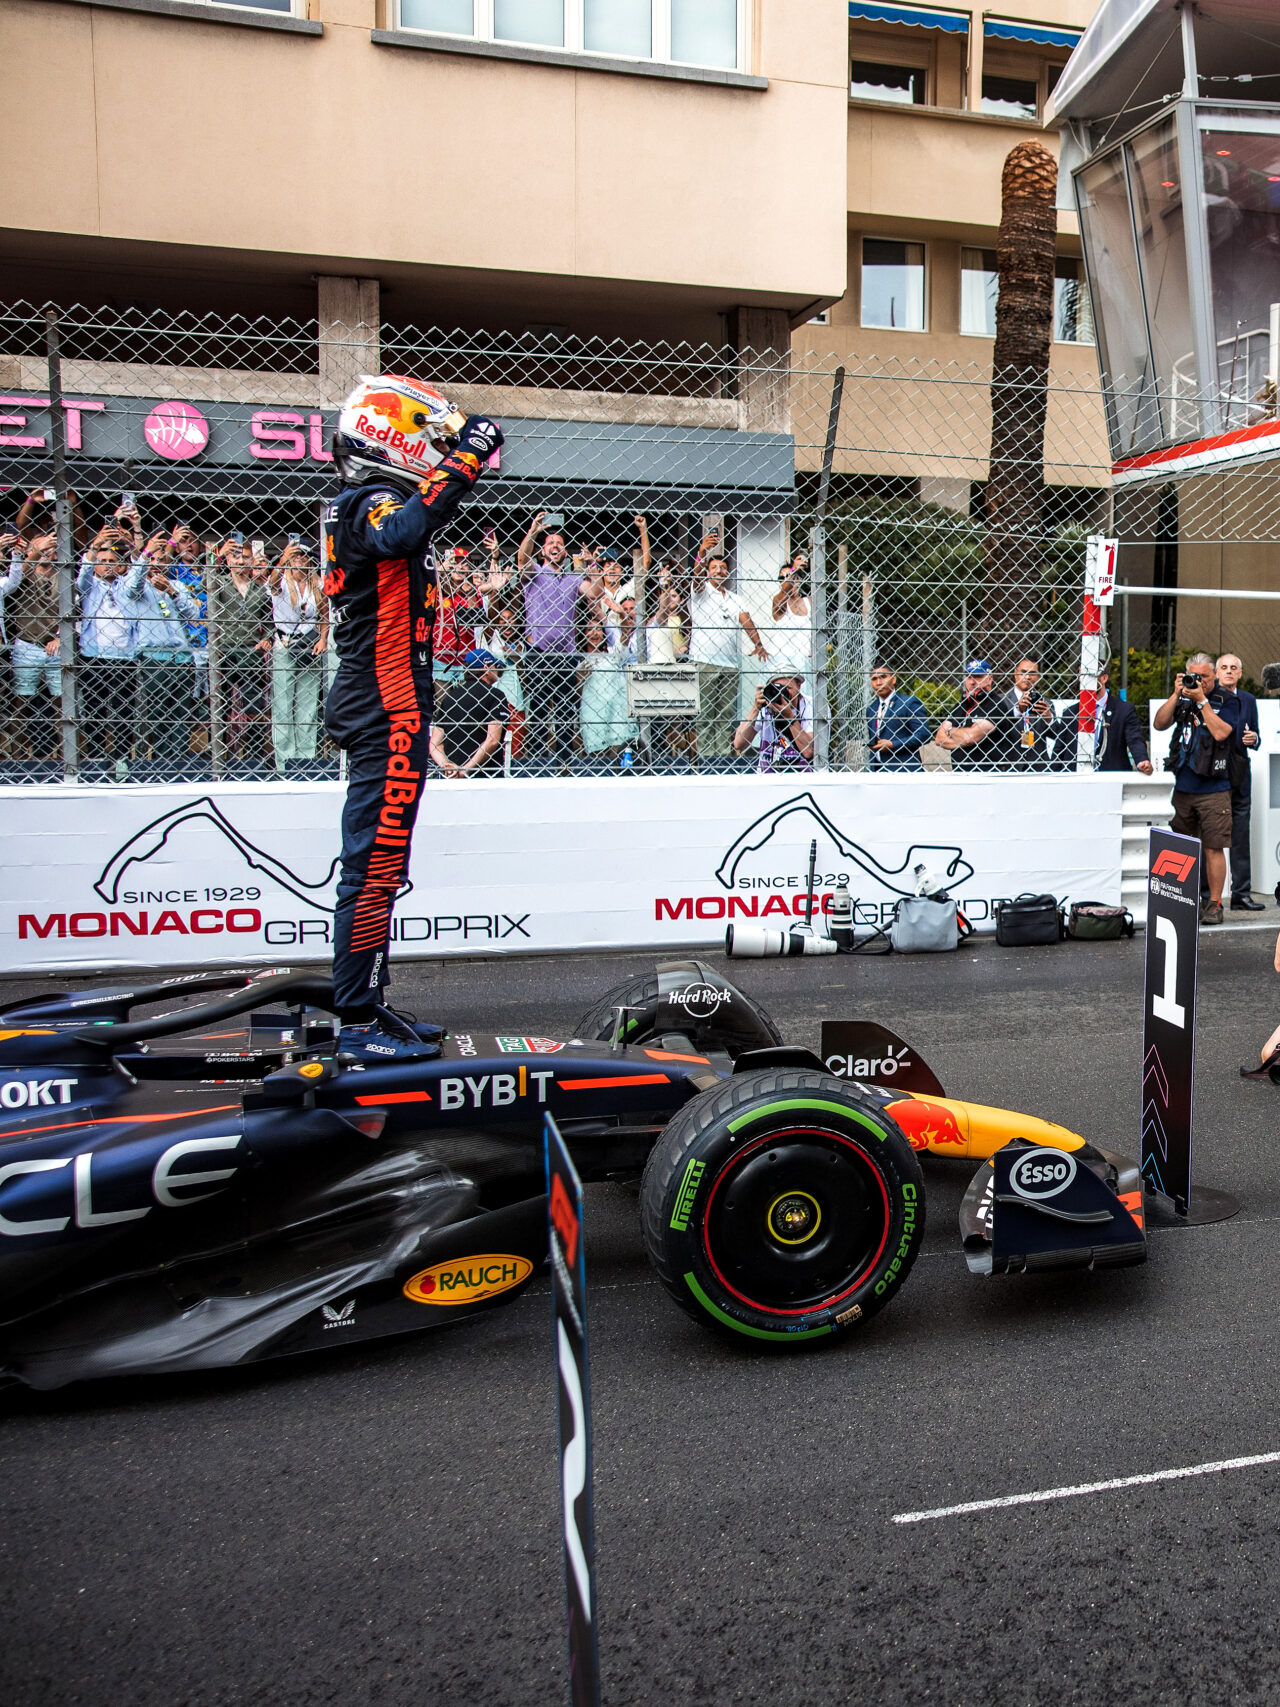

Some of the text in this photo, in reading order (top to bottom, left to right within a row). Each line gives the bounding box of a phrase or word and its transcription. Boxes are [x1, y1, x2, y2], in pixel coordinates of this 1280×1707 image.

[1099, 576, 1112, 584] FIRE
[739, 873, 850, 889] SINCE 1929
[123, 886, 261, 903] SINCE 1929
[18, 908, 532, 945] MONACO GRDPRIX
[370, 952, 384, 988] sparco
[1153, 915, 1185, 1029] 1
[668, 988, 731, 1005] Hard Rock
[365, 1043, 396, 1055] sparco
[503, 1038, 524, 1052] TAG
[0, 1078, 78, 1109] OKT
[440, 1065, 554, 1110] BYBIT
[1020, 1163, 1066, 1185] Esso
[669, 1158, 707, 1232] PIRELLI
[874, 1183, 917, 1296] Cinturato
[439, 1261, 517, 1291] RAUCH
[323, 1319, 356, 1330] CASTORE
